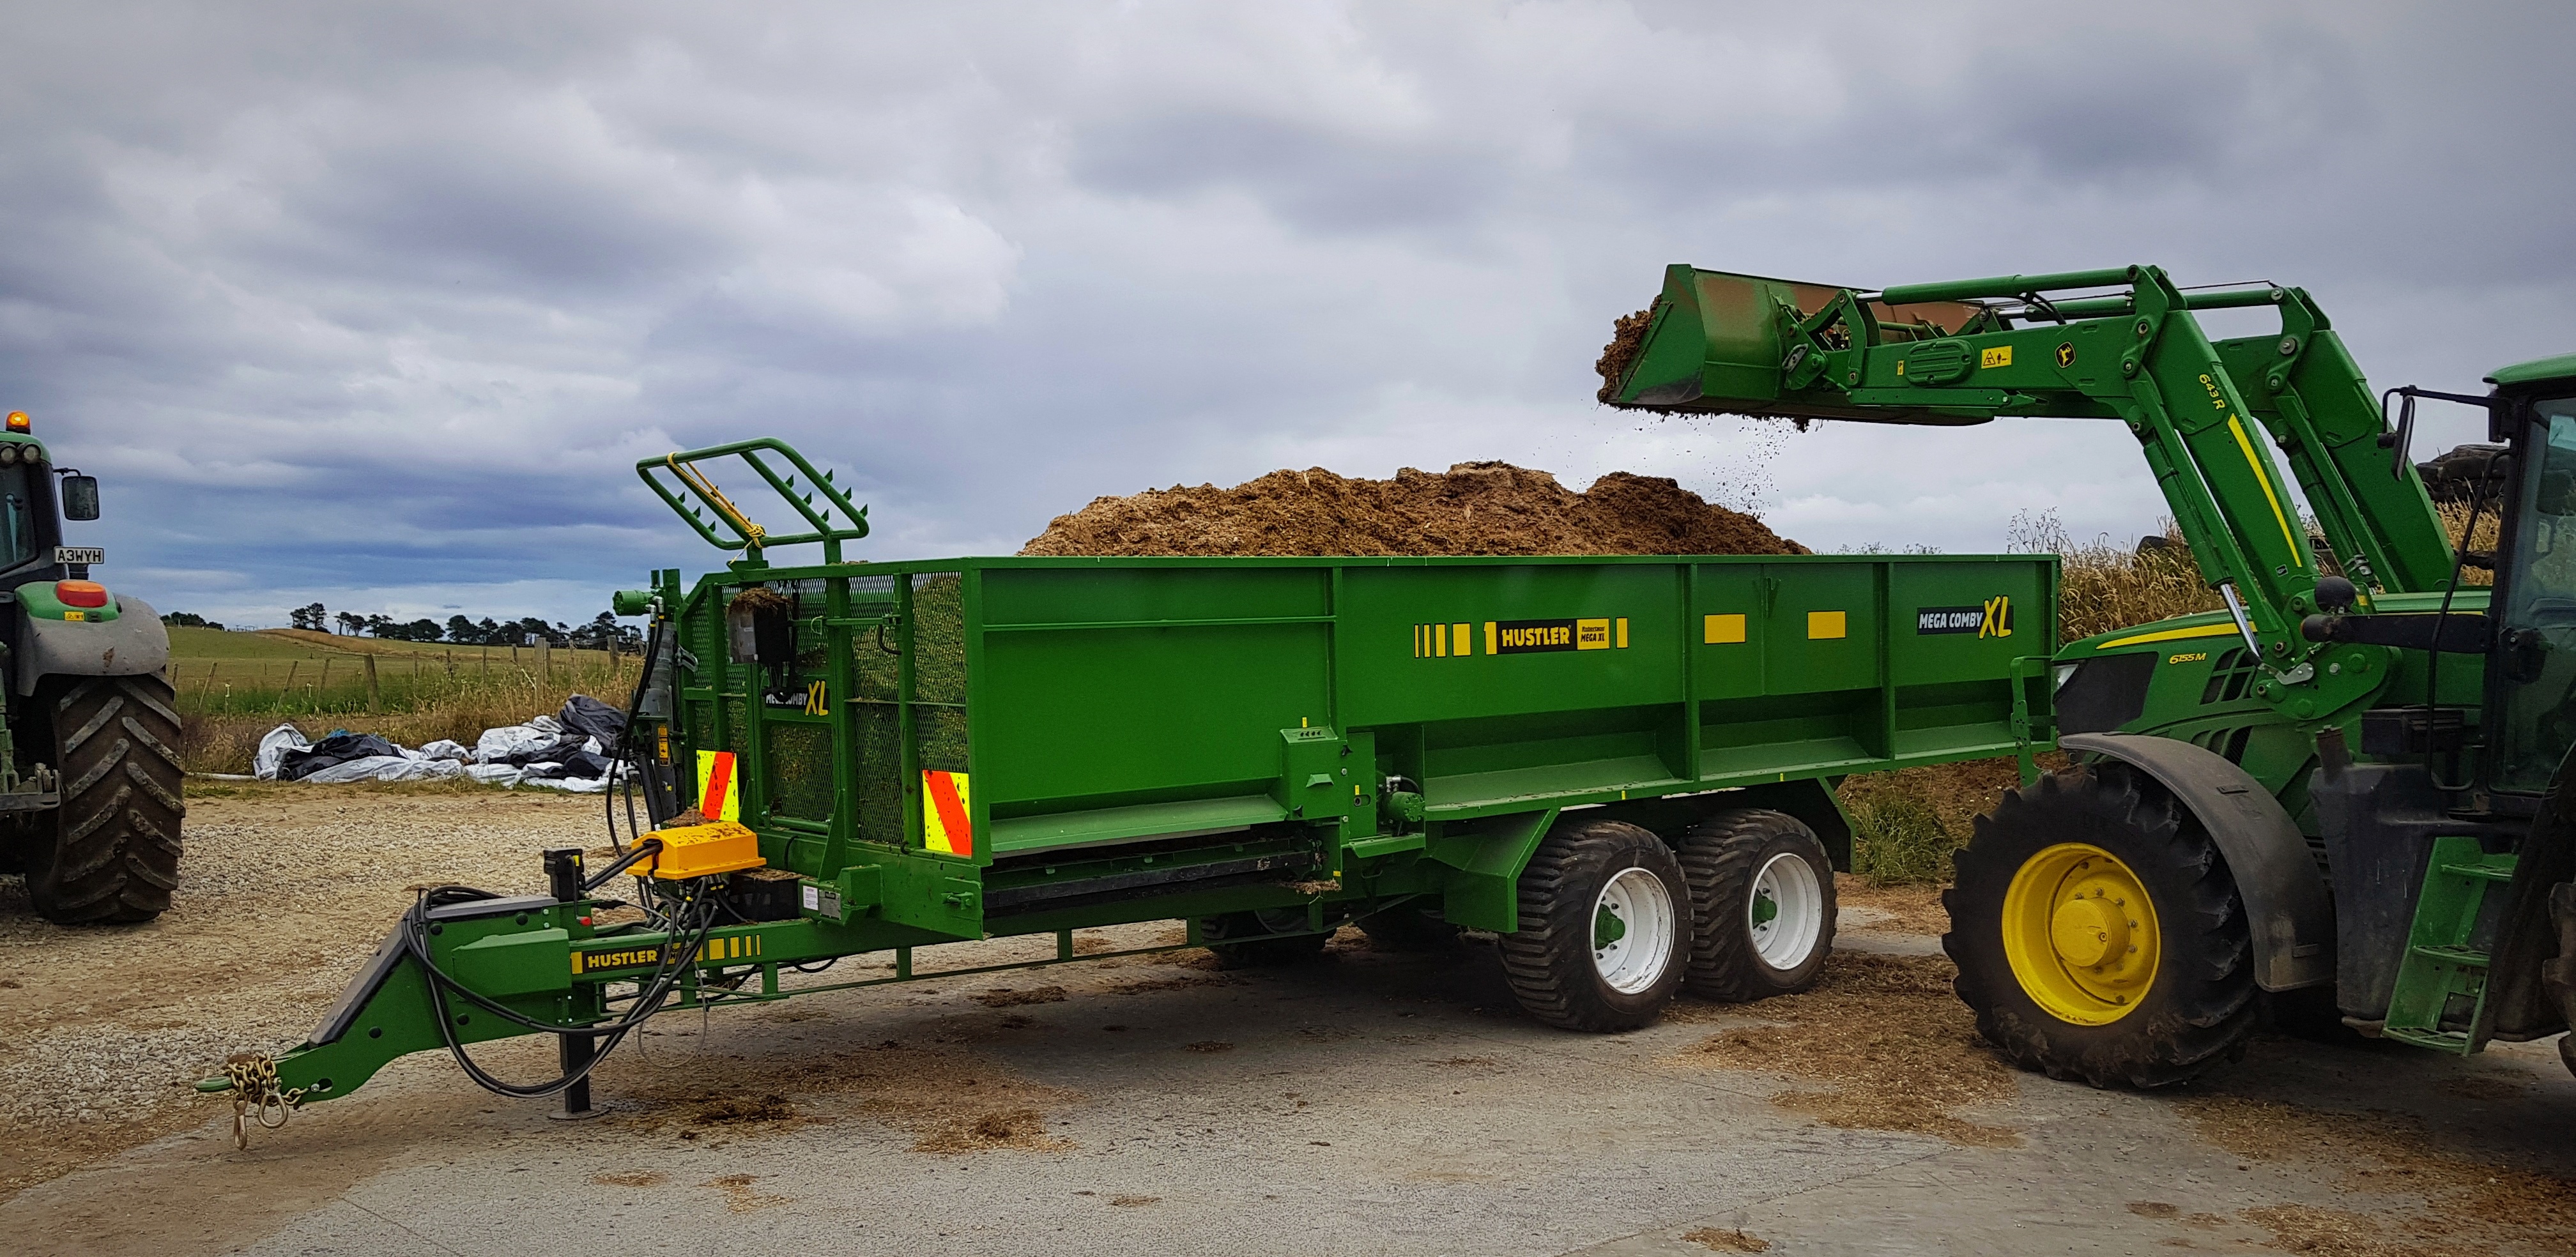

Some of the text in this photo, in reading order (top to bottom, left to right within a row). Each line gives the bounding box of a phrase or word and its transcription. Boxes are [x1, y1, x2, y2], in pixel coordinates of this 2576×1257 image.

[57, 549, 101, 562] A3WYH
[1919, 596, 2012, 639] MEGA COMBY XL
[1501, 627, 1570, 647] HUSTLER
[1581, 632, 1605, 643] MEGA XL
[805, 680, 829, 716] XL
[588, 950, 657, 968] HUSTLER
